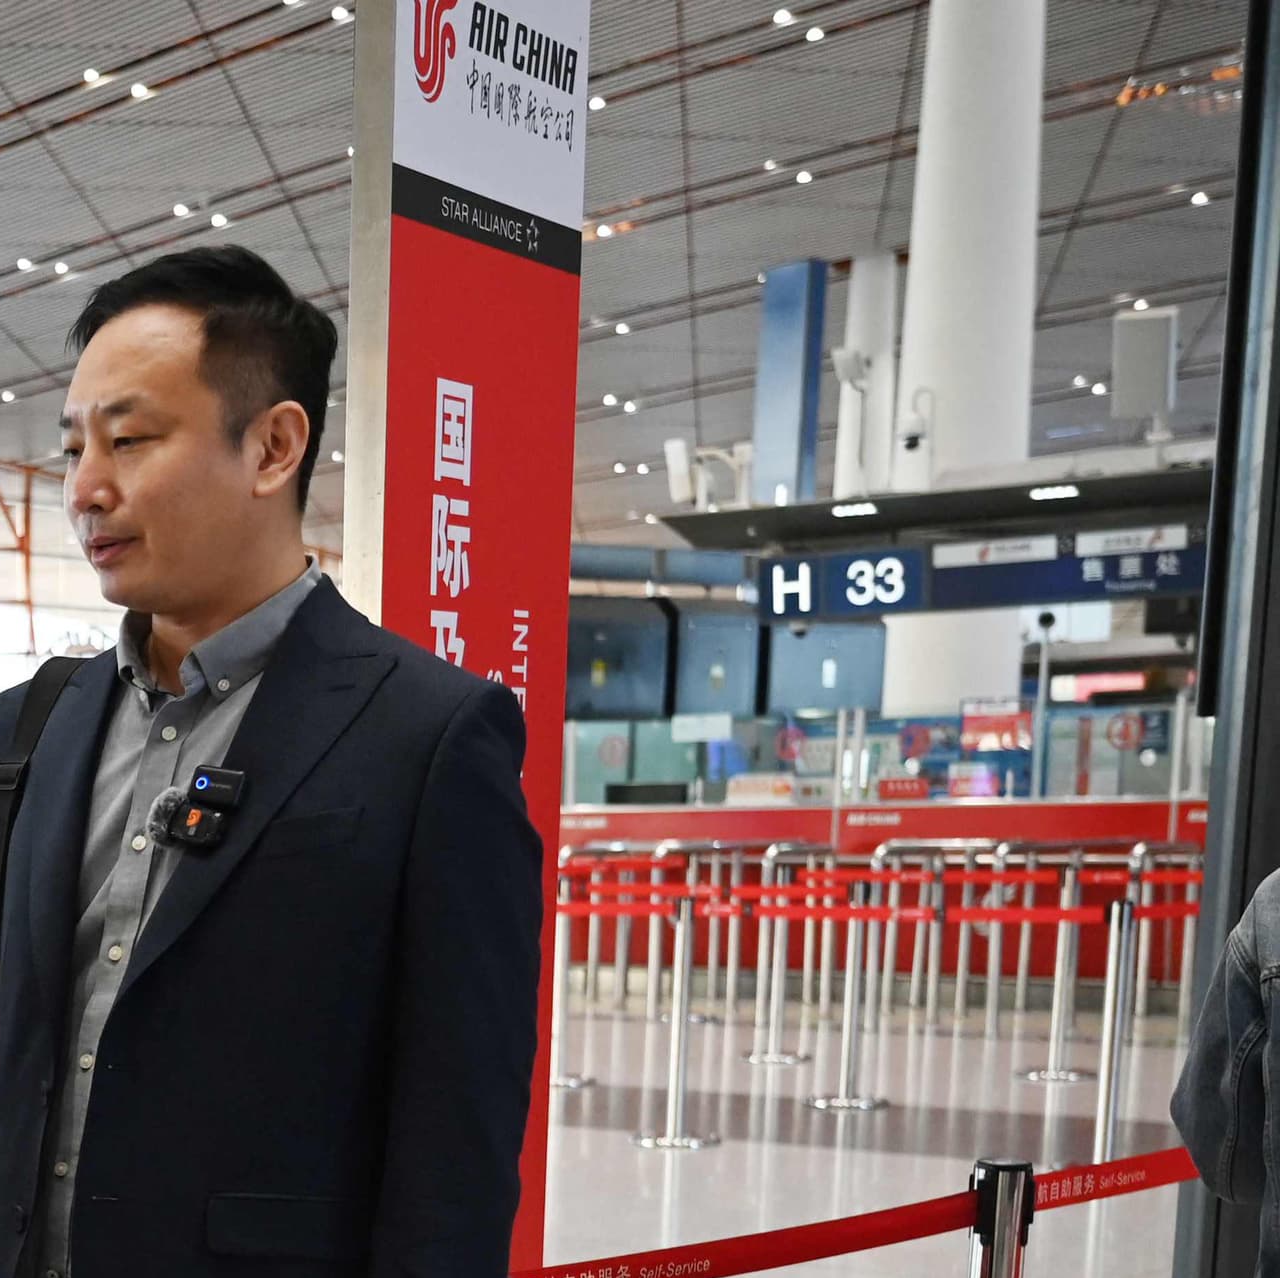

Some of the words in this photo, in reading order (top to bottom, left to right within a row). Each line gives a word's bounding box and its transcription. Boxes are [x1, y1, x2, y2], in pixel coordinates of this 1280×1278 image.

[469, 1, 510, 64] AIR
[512, 22, 578, 95] CHINA
[441, 196, 469, 224] STAR
[471, 208, 522, 242] ALLIANCE
[772, 561, 811, 615] H
[846, 556, 906, 606] 33
